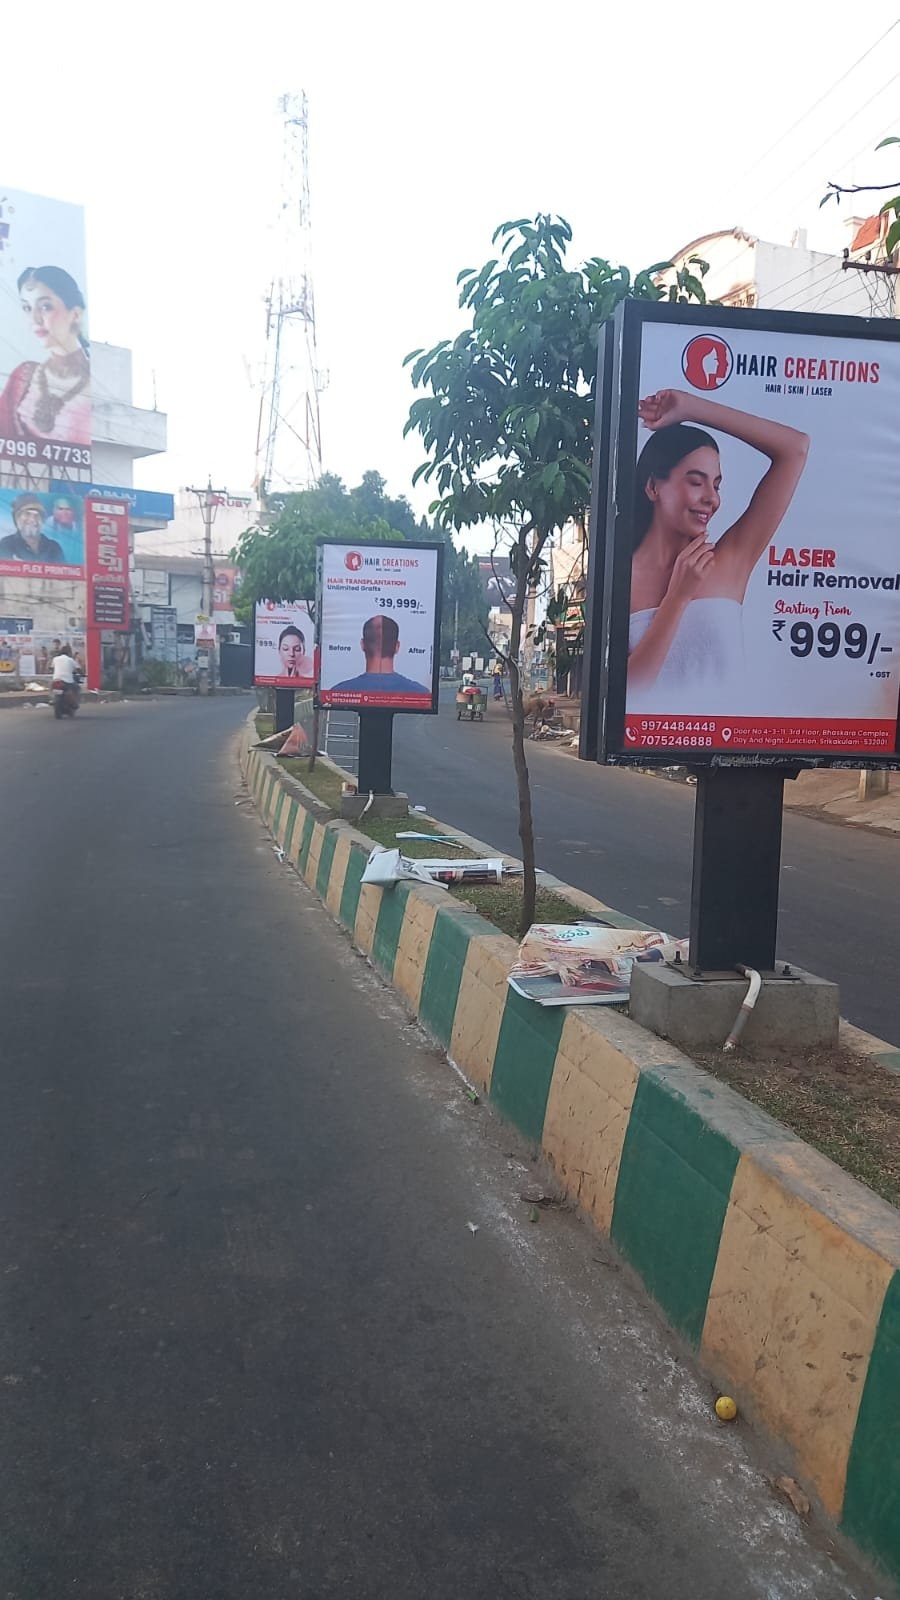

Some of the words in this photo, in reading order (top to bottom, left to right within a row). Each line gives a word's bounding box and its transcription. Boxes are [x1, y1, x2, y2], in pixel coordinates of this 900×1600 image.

[736, 354, 777, 377] HAIR
[784, 356, 880, 384] CREATIONS
[765, 384, 781, 393] HAIR
[788, 385, 804, 394] SKIN
[811, 387, 833, 396] LASER
[41, 444, 91, 465] 47733
[364, 557, 380, 566] HAIR
[382, 558, 419, 568] CREATIONS
[768, 545, 836, 568] LASER
[767, 569, 809, 587] Hair
[813, 571, 900, 590] Removal
[774, 599, 820, 620] Starting
[822, 600, 852, 616] From
[640, 720, 716, 732] 9974484448
[640, 735, 712, 746] 7075246888
